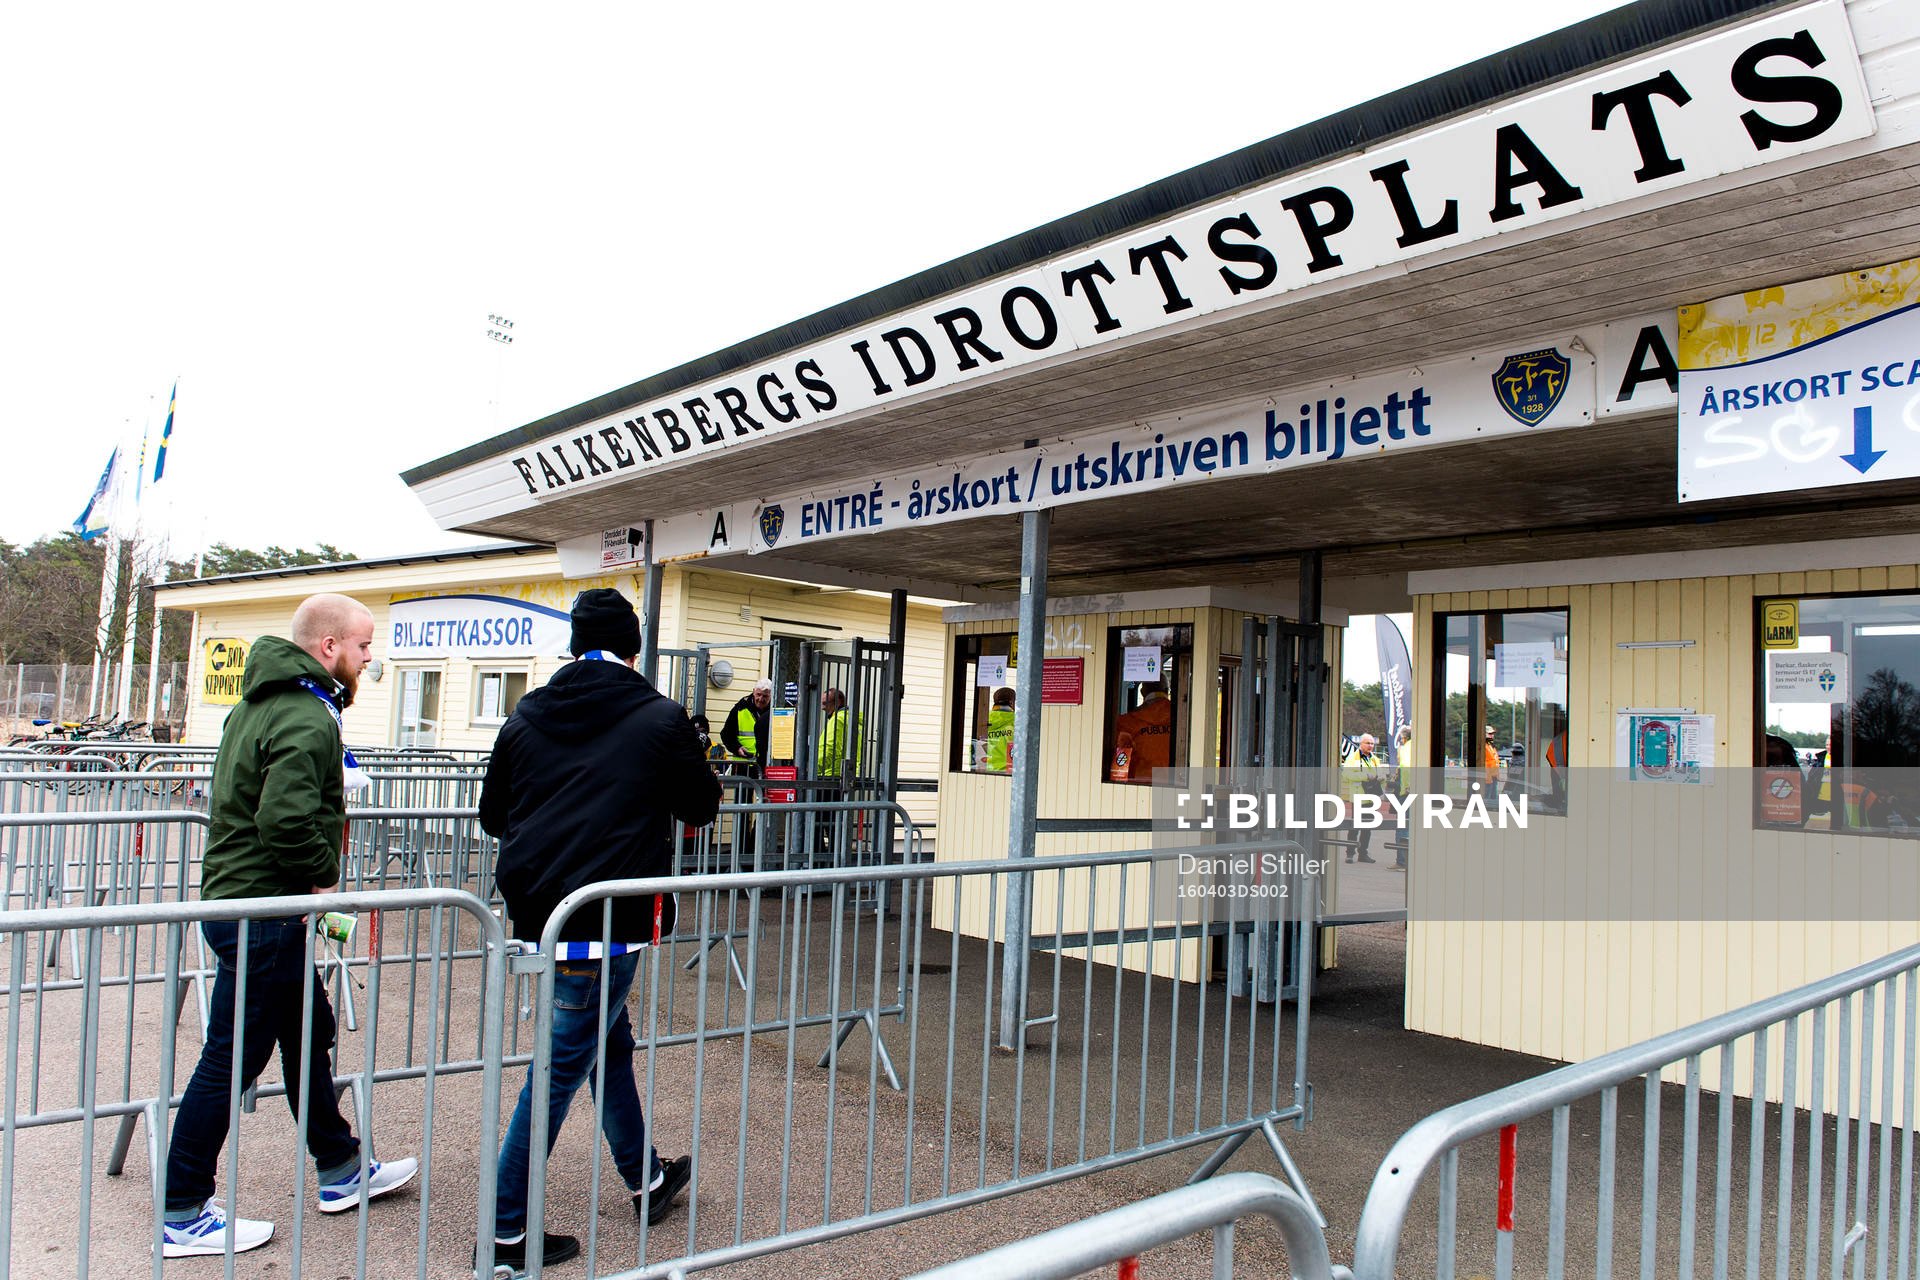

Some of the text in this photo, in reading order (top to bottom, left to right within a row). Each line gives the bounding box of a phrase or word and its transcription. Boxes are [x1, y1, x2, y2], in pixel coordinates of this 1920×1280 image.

[512, 29, 1844, 494] FALKENBERGS IDROTTSPLATS
[1615, 324, 1678, 403] A
[1521, 403, 1544, 414] 1928
[1699, 370, 1852, 416] ÅRSKORT
[801, 481, 883, 538] ENTRÉ
[907, 465, 1021, 520] årskort
[1051, 430, 1249, 496] utskriven
[1265, 386, 1432, 460] biljett
[710, 511, 728, 548] A
[394, 617, 533, 647] BILJETTKASSOR
[1766, 626, 1794, 641] LARM
